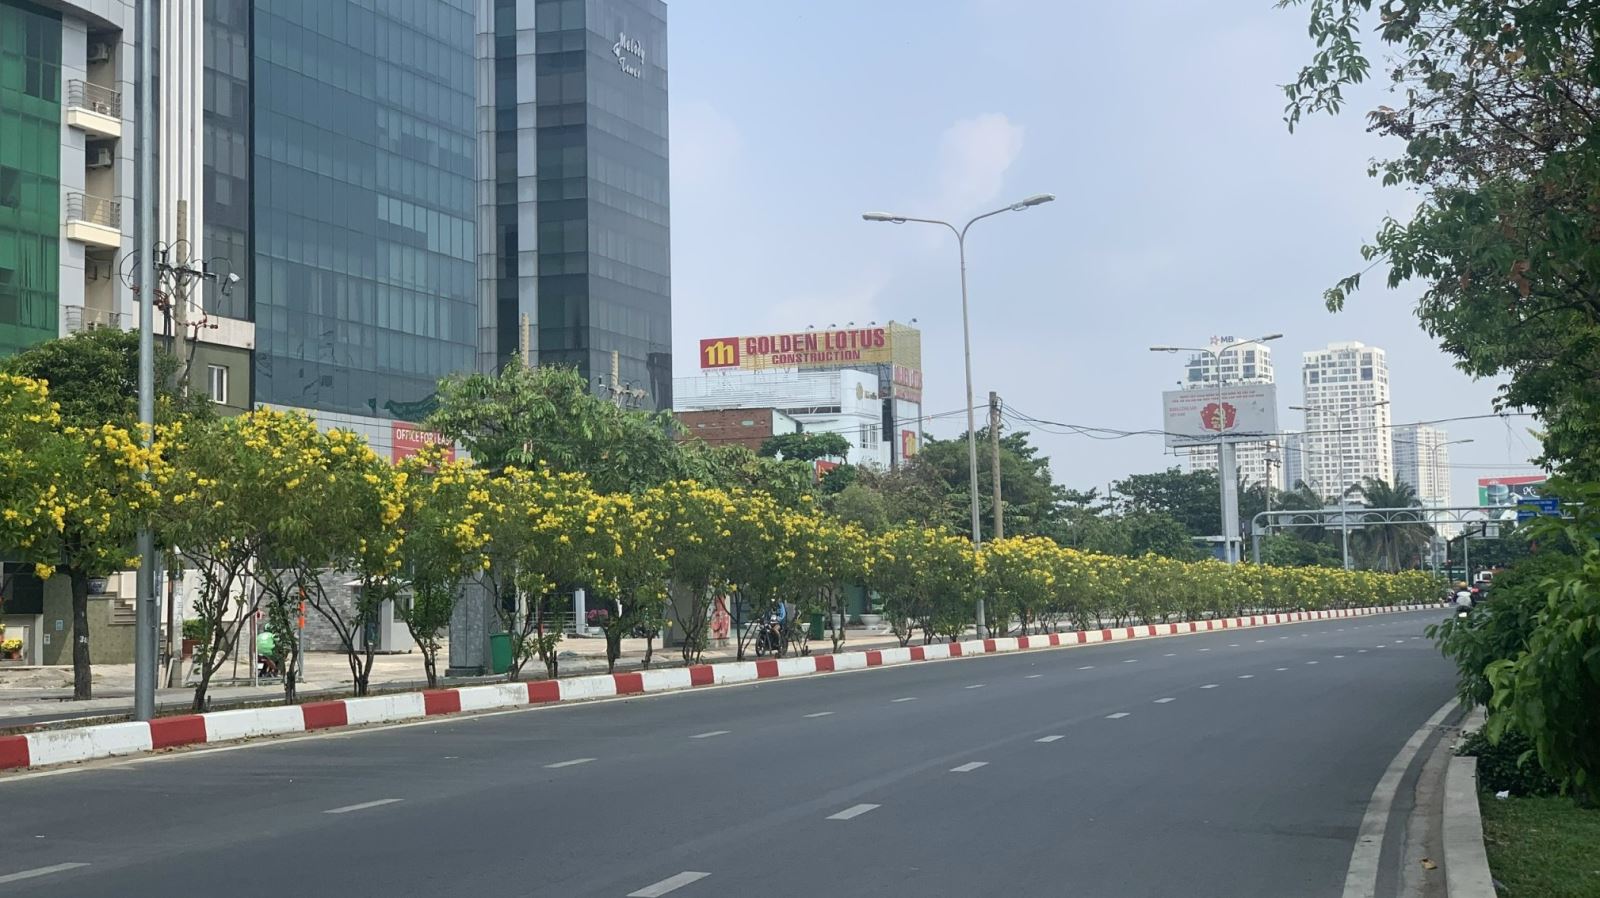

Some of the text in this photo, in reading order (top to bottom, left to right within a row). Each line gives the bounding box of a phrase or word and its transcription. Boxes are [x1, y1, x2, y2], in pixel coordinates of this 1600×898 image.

[745, 327, 886, 356] GOLDEN LOTUS
[1220, 335, 1234, 344] MB
[771, 350, 861, 365] CONSTRUCTION
[396, 428, 420, 443] OFFICE
